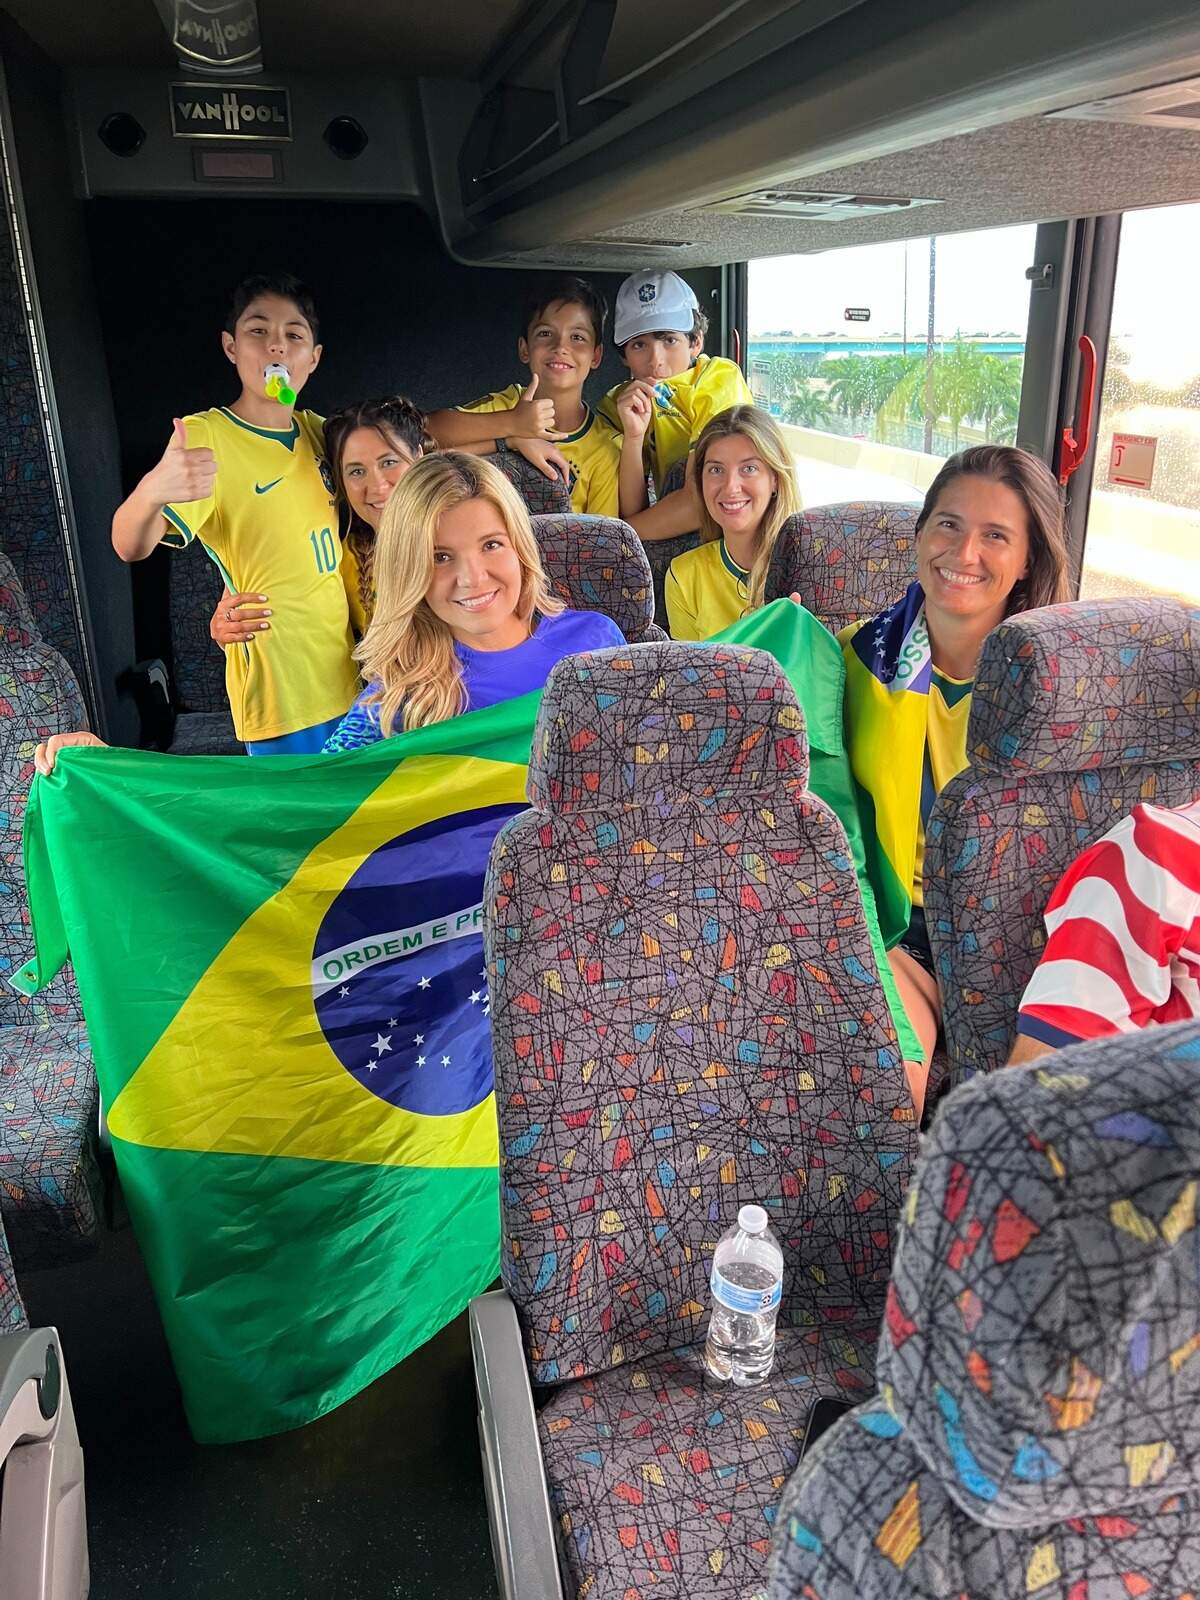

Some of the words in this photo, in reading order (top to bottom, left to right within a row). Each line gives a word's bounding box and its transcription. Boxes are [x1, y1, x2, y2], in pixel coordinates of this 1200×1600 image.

[656, 410, 681, 418] BRASIL
[310, 527, 337, 574] 10
[322, 931, 423, 981] ORDEM
[432, 922, 447, 939] E
